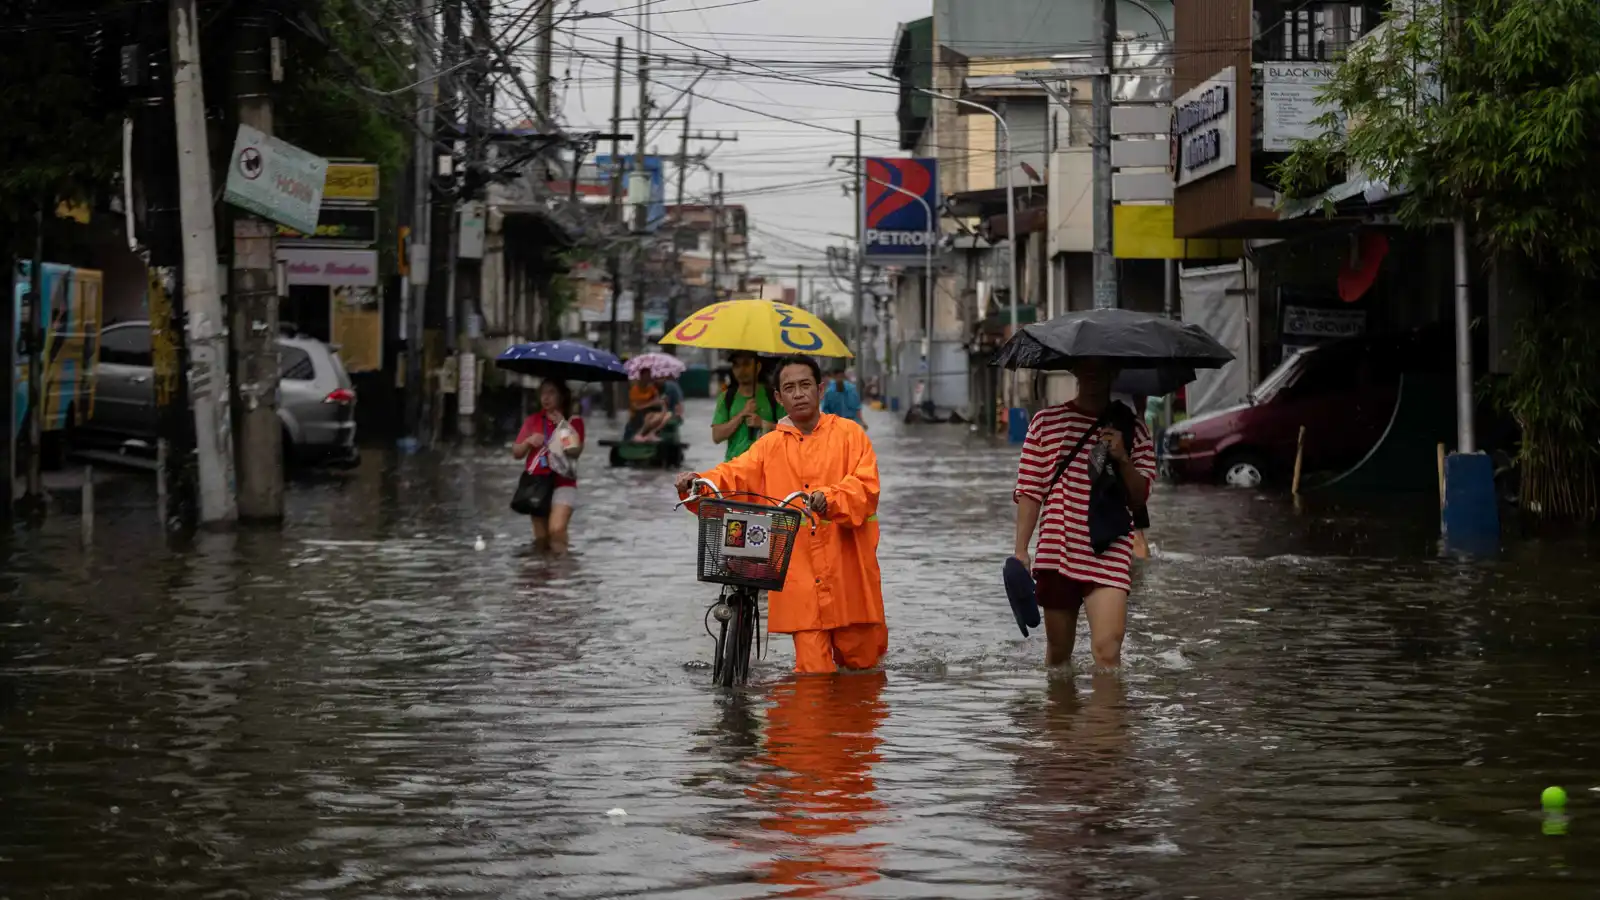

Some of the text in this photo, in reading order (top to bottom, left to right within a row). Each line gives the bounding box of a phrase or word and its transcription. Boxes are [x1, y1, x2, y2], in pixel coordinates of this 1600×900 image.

[1269, 67, 1309, 77] BLACK
[676, 303, 733, 342] CM
[773, 304, 823, 351] CM
